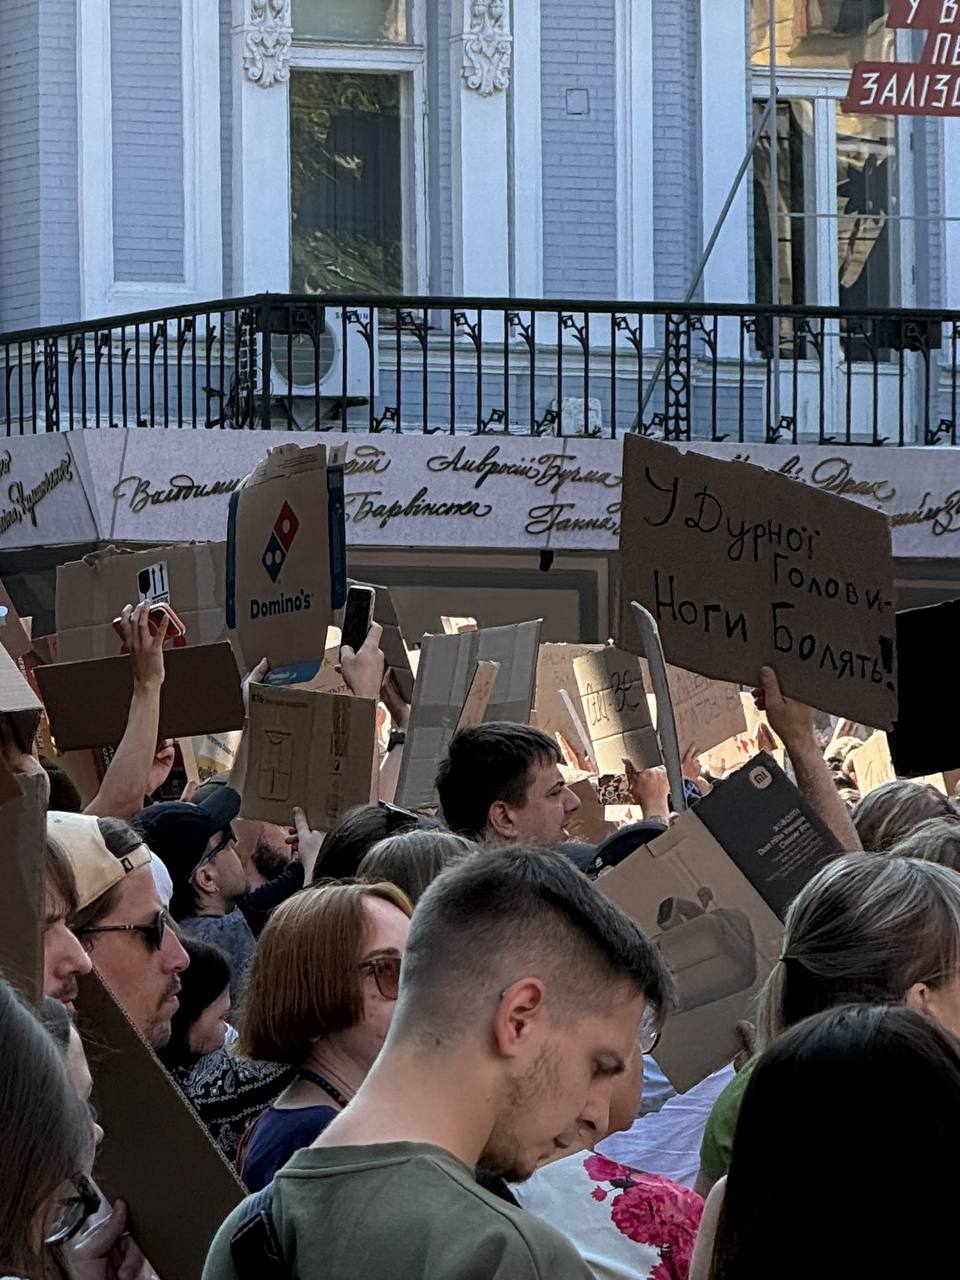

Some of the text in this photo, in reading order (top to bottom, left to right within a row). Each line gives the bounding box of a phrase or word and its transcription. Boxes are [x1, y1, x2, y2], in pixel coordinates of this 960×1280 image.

[112, 474, 242, 513] Володими
[644, 467, 679, 526] У
[685, 485, 821, 562] Дурної
[250, 588, 312, 619] Domino's
[653, 570, 748, 642] Ноги
